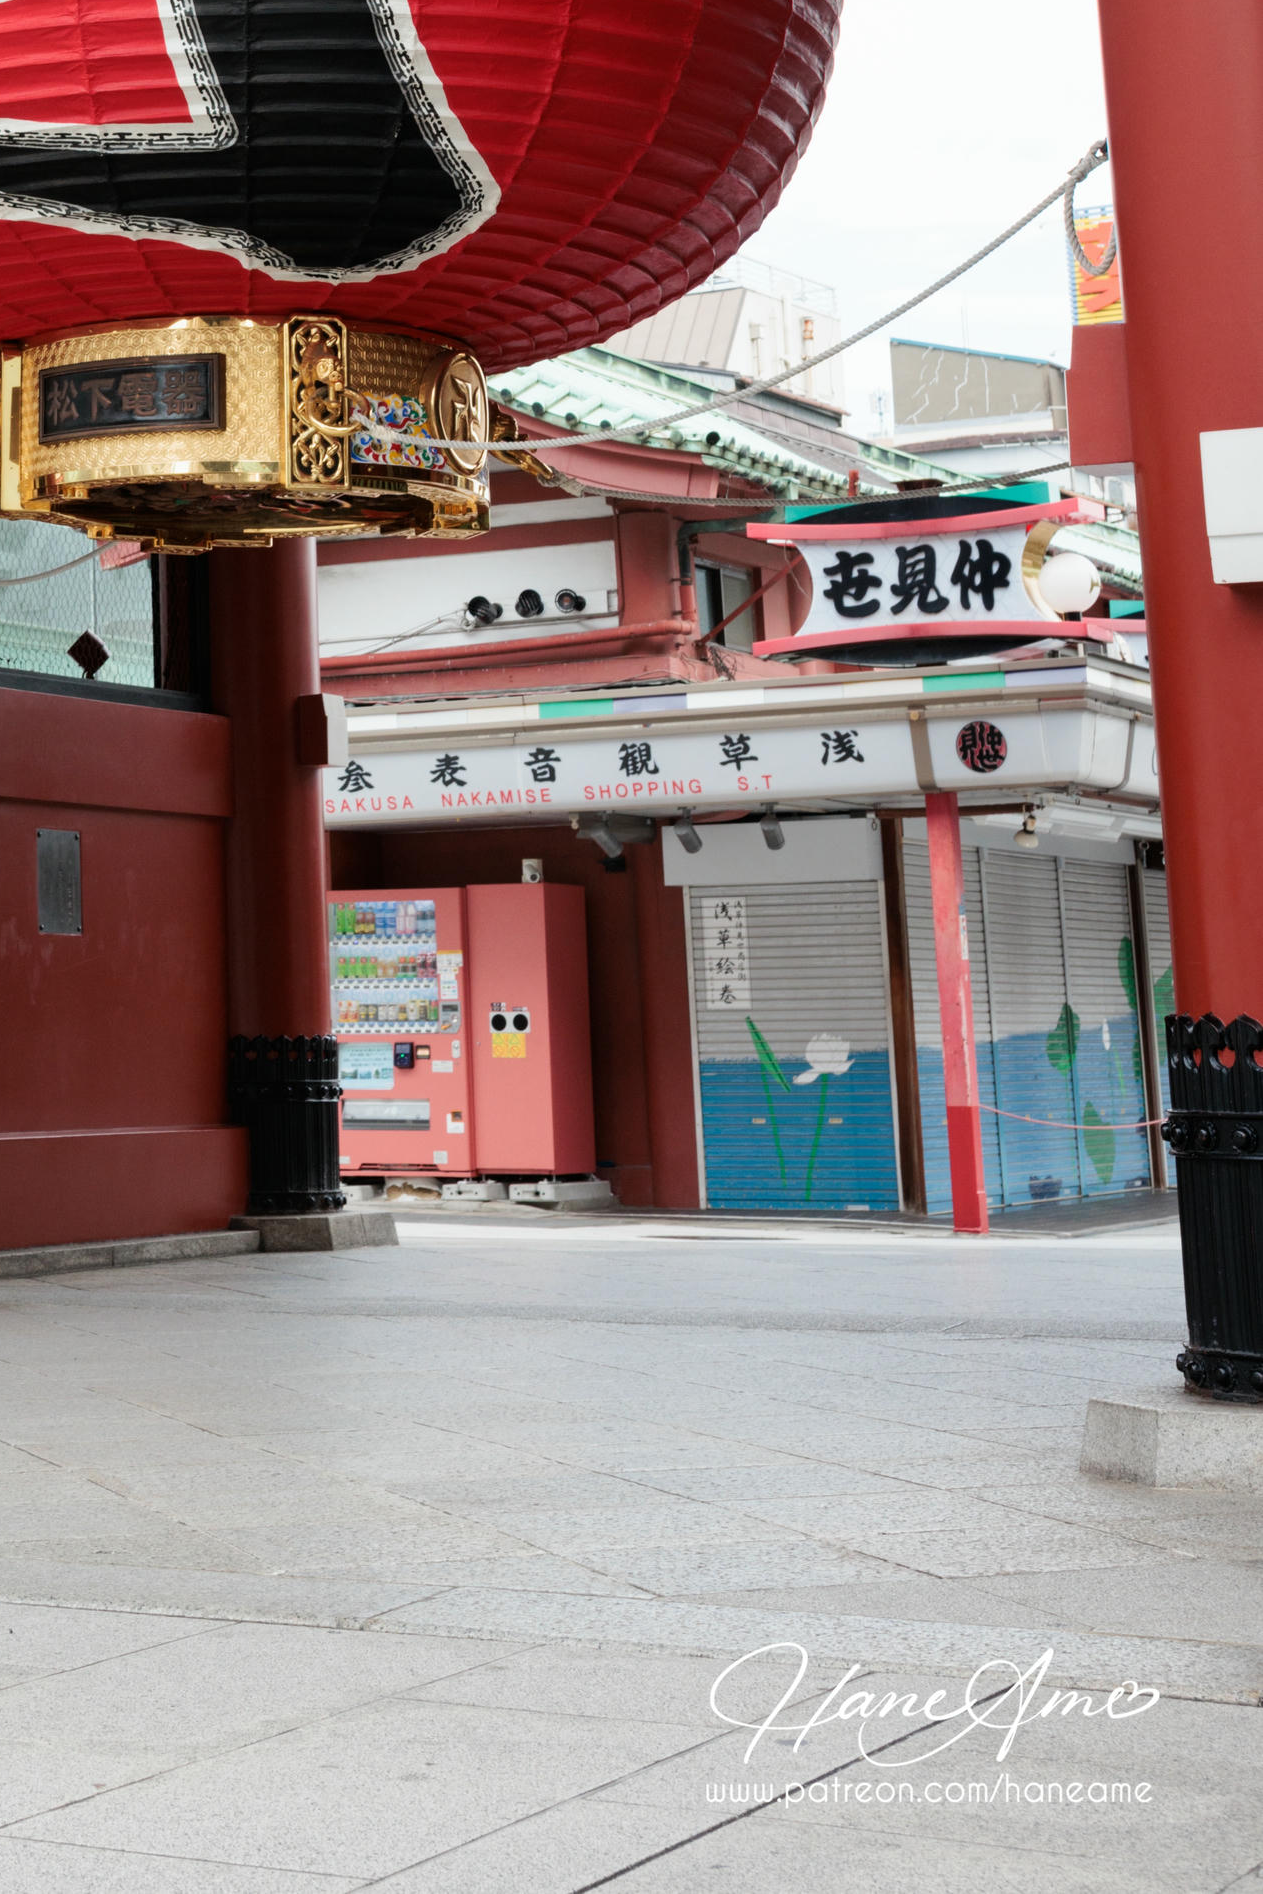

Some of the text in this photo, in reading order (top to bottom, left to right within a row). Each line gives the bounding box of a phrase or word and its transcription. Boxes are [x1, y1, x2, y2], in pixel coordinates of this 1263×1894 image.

[47, 367, 206, 424] 松下電器
[441, 787, 553, 808] NAKAMISE
[583, 778, 703, 801] SHOPPING
